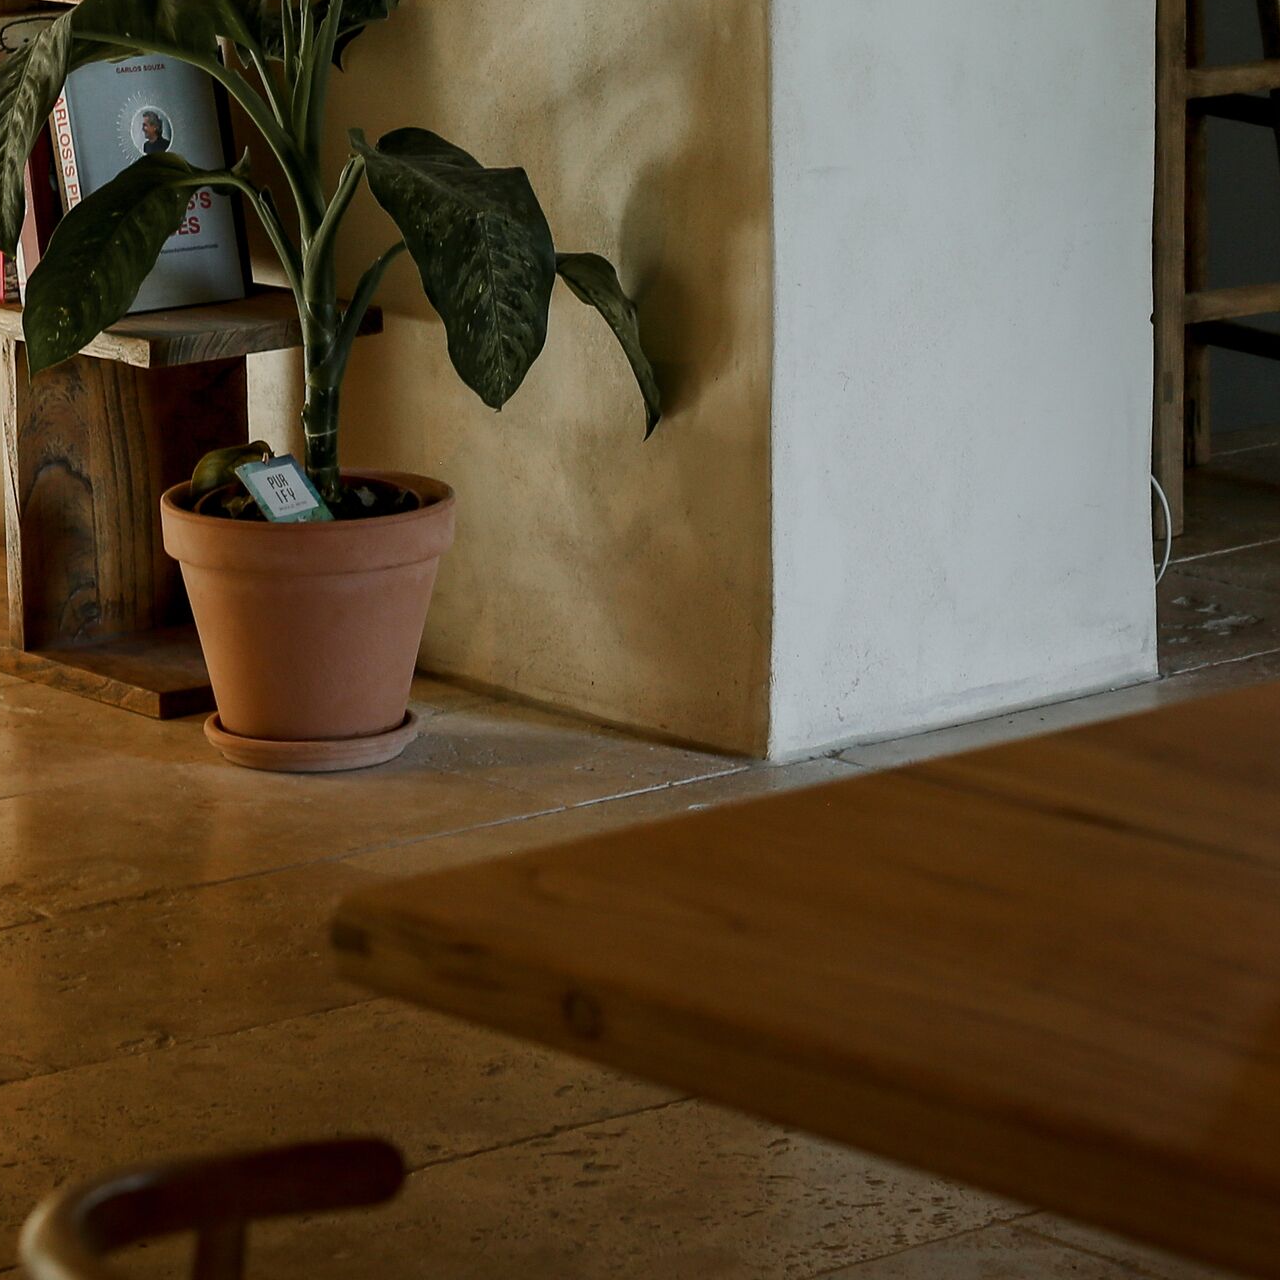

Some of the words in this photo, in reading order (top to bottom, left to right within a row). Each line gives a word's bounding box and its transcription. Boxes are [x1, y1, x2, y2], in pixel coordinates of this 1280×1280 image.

[115, 64, 142, 74] CARLOS
[144, 63, 166, 73] SOUZA
[54, 97, 75, 177] ARLOS'S
[267, 472, 289, 490] PUR
[275, 487, 297, 504] IFY
